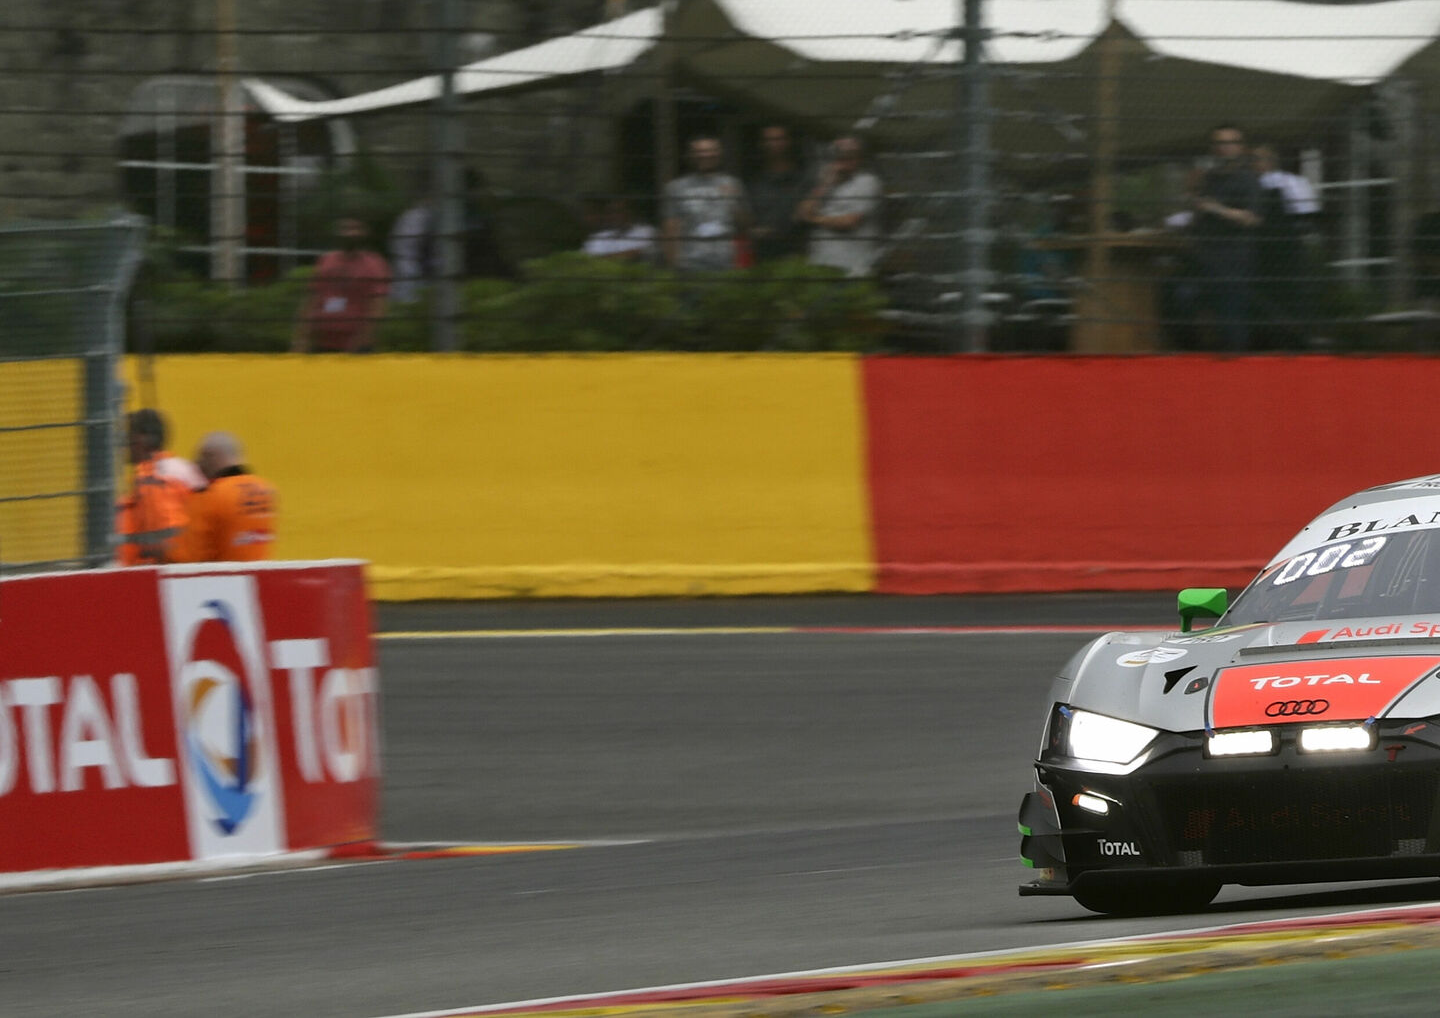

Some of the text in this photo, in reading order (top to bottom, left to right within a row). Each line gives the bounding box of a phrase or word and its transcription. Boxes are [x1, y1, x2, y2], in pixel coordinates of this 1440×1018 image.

[1274, 536, 1387, 585] 002
[1331, 623, 1403, 641] Audi
[1251, 673, 1381, 691] TOTAL
[1097, 839, 1140, 856] TOTAL
